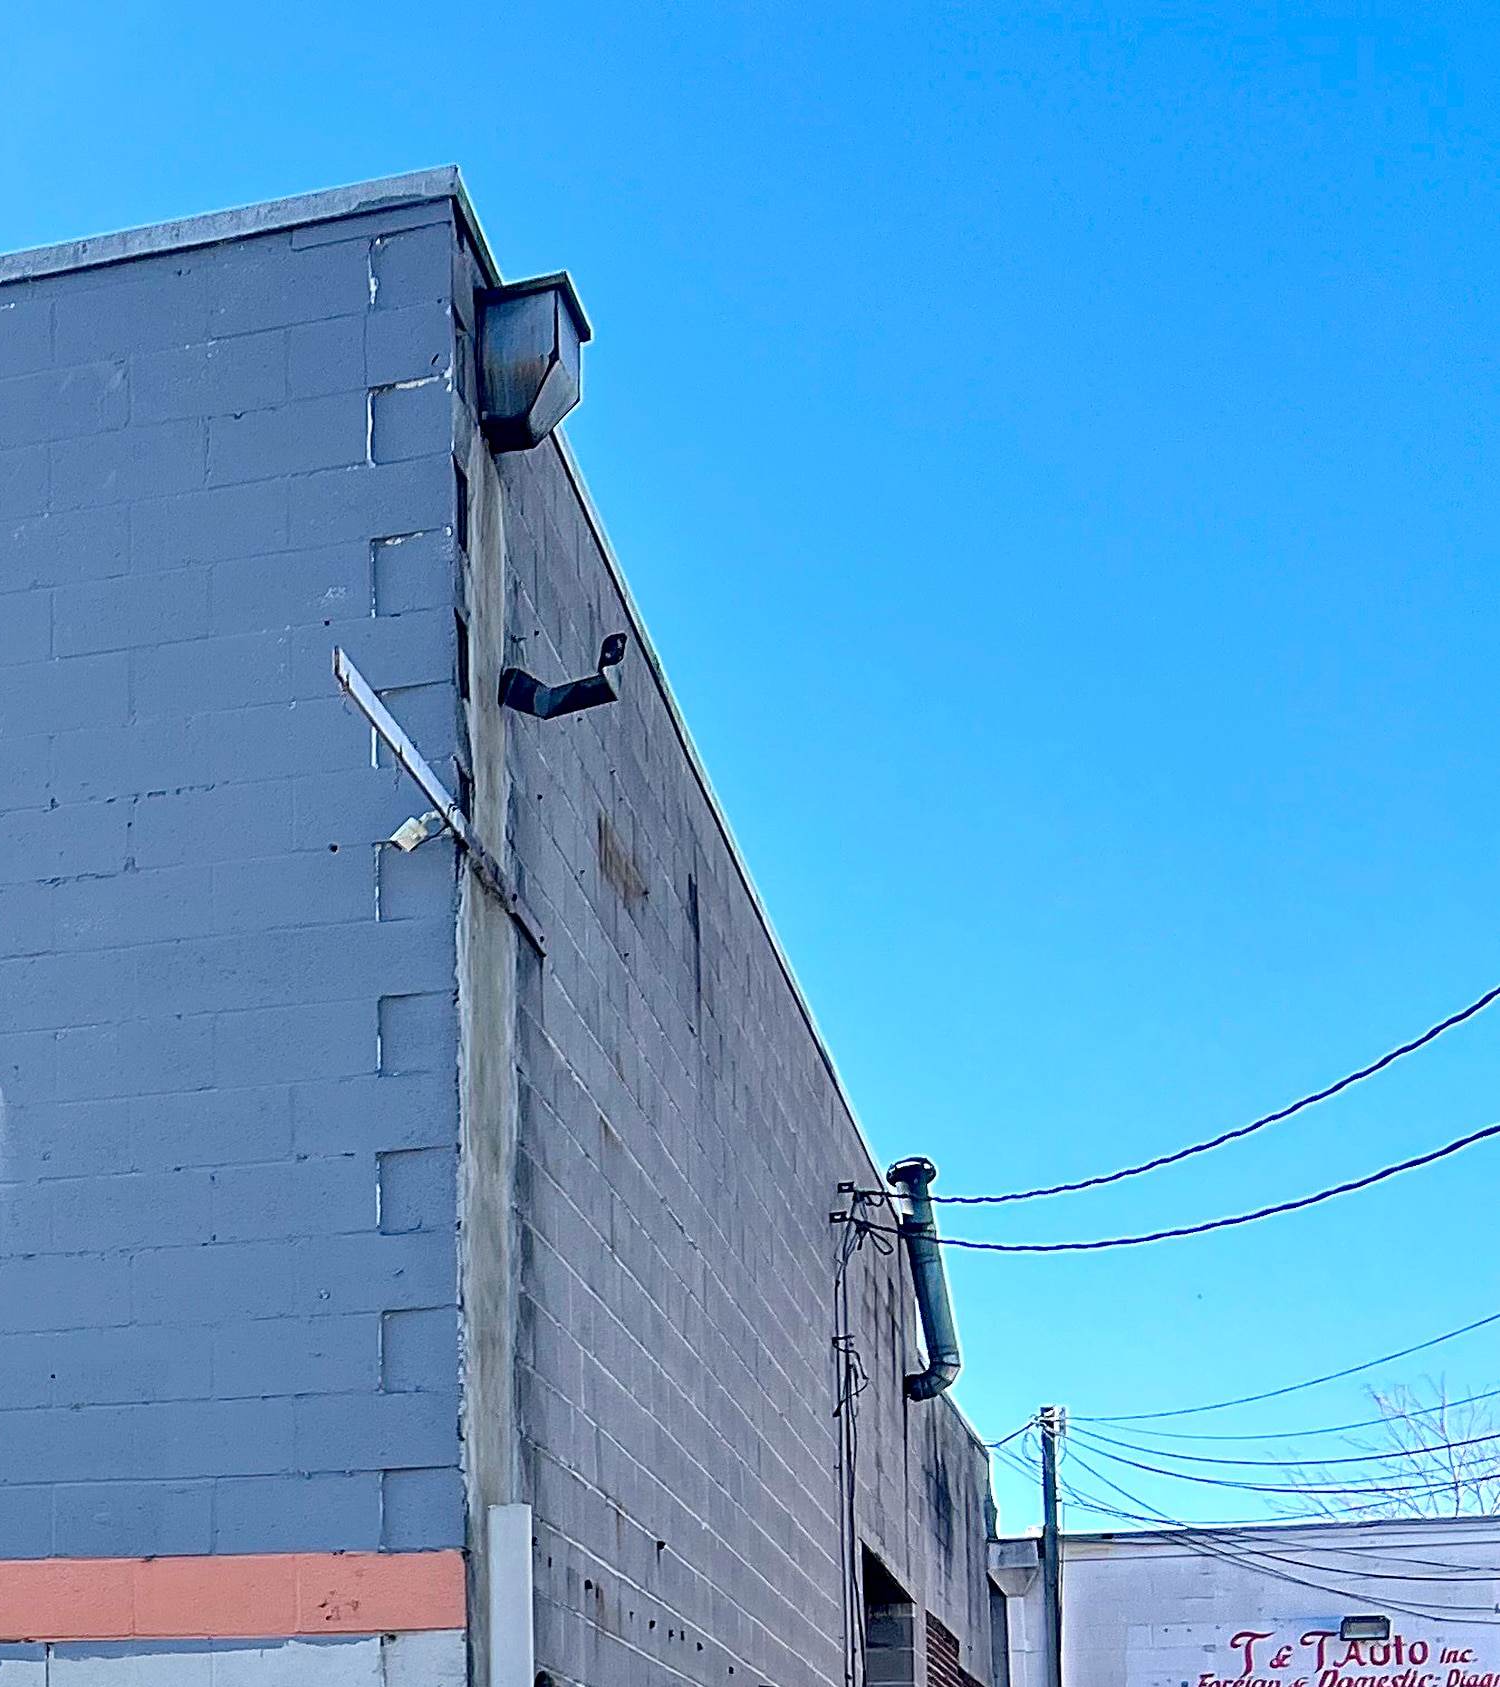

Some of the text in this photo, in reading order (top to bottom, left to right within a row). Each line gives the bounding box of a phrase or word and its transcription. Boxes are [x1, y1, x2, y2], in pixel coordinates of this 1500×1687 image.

[1230, 1631, 1276, 1678] T
[1269, 1645, 1293, 1669] &
[1300, 1631, 1341, 1674] T
